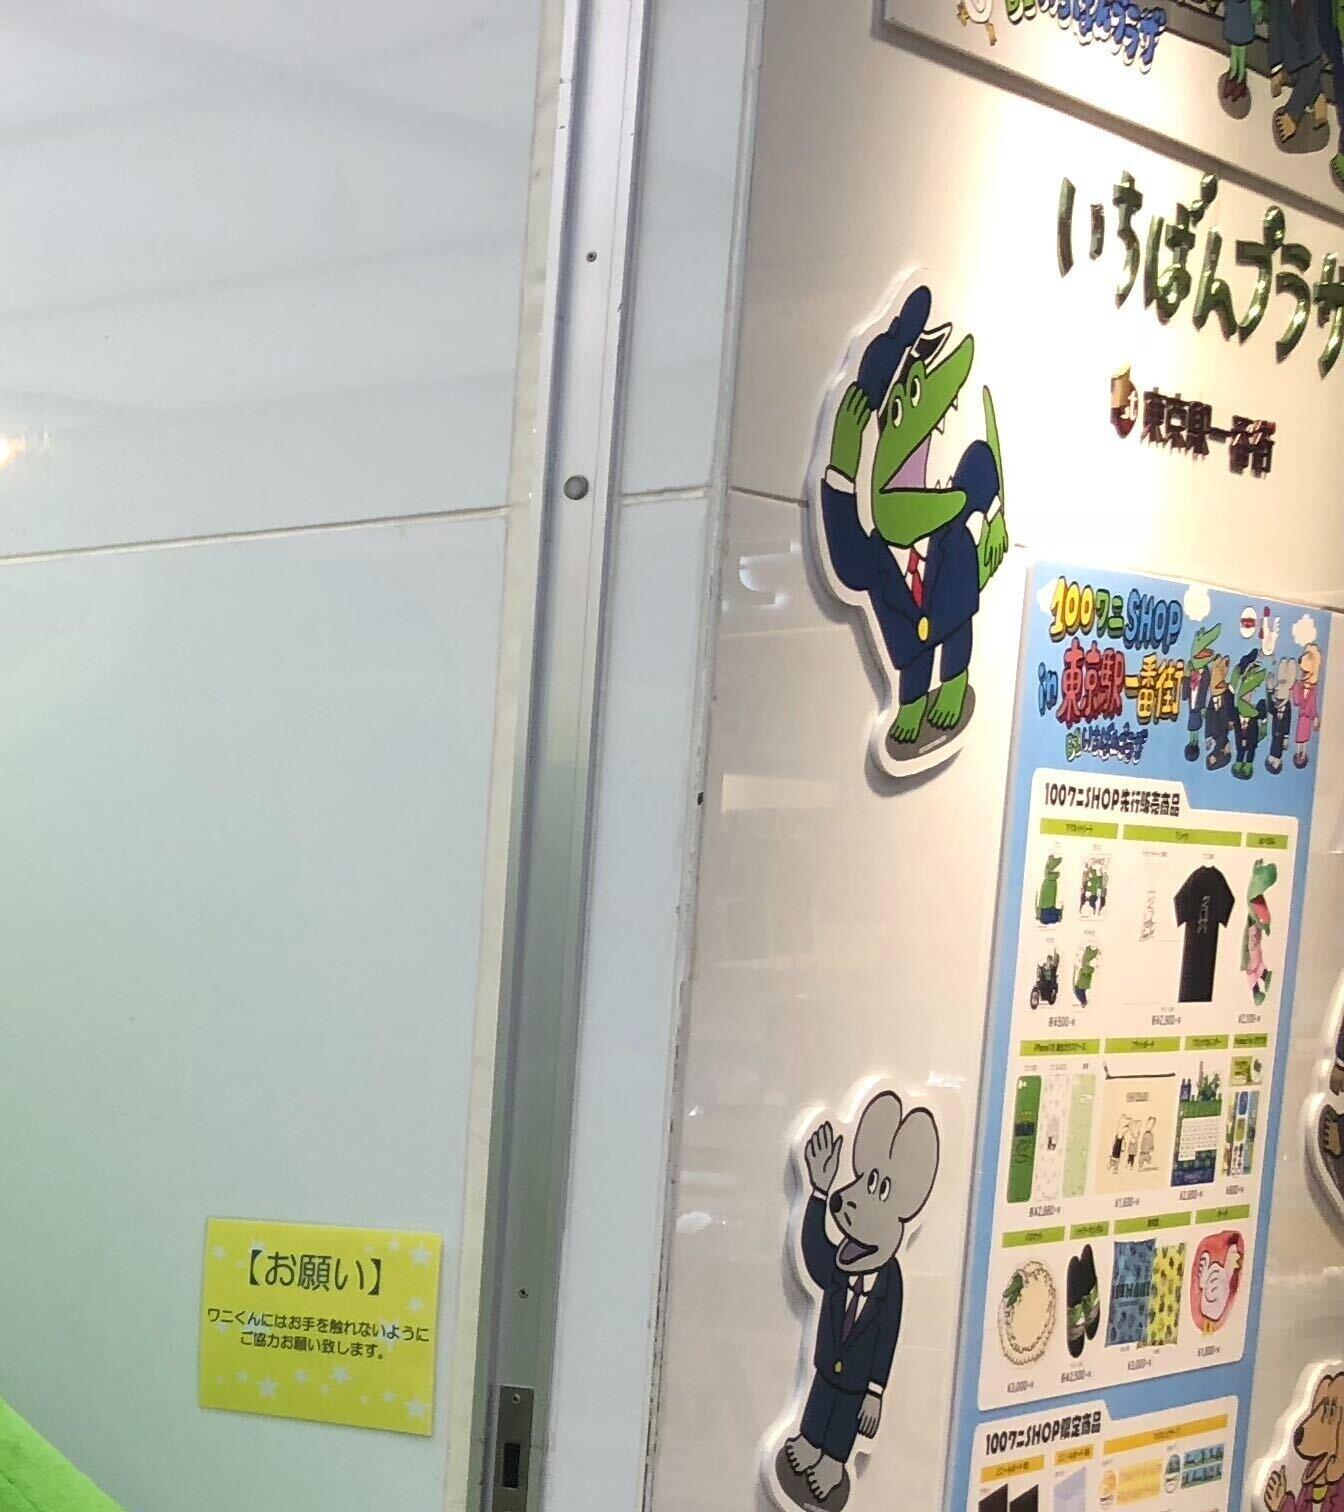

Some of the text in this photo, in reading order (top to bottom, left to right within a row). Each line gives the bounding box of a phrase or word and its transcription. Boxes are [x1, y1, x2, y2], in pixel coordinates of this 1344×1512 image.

[1048, 575, 1183, 655] 100ワニSHOP
[248, 1248, 382, 1296] 【お願い】
[207, 1308, 431, 1342] ワニくんにはお手を触れないように
[240, 1331, 384, 1360] ご協力お願い致します。
